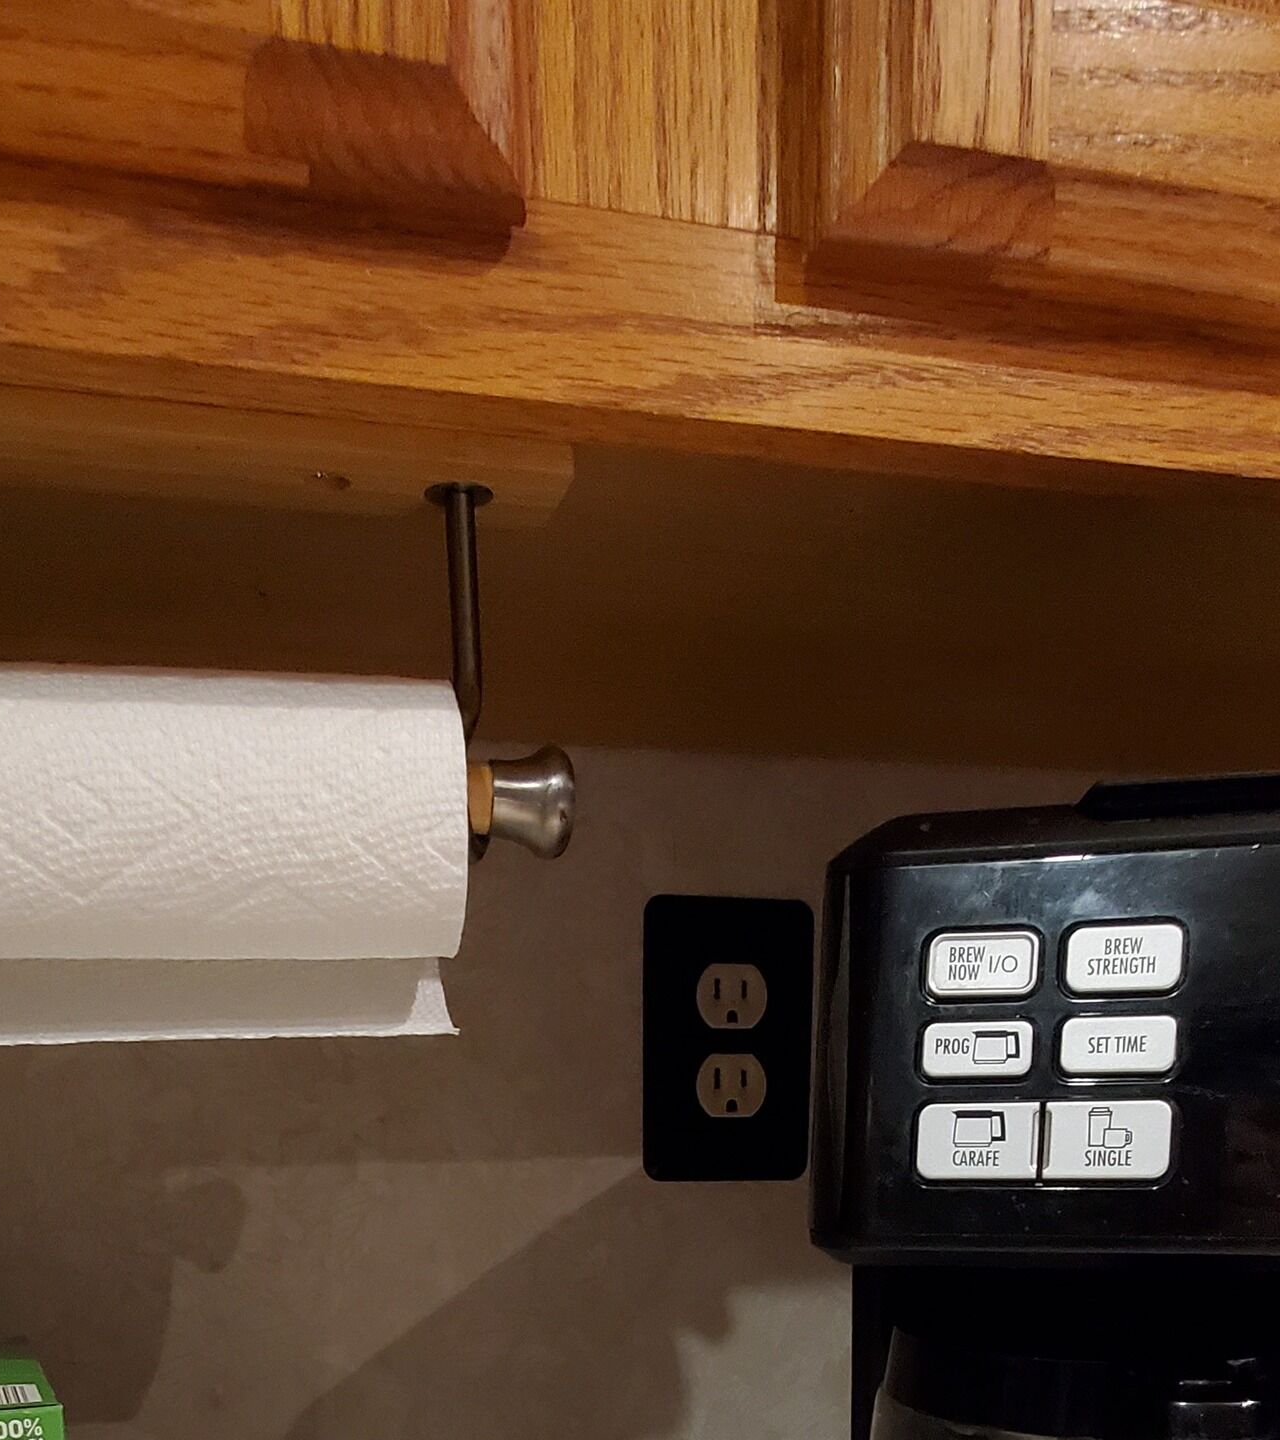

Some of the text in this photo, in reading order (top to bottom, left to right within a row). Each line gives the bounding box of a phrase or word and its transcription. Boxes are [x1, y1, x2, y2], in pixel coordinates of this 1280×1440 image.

[948, 946, 986, 963] BREW
[1104, 937, 1143, 955] BREW
[948, 964, 980, 981] NOW
[1087, 956, 1156, 976] STRENGTH
[935, 1038, 970, 1055] PROG
[1088, 1035, 1148, 1054] SET TIME
[952, 1150, 1000, 1167] CARAFE
[1084, 1150, 1133, 1167] SINGLE
